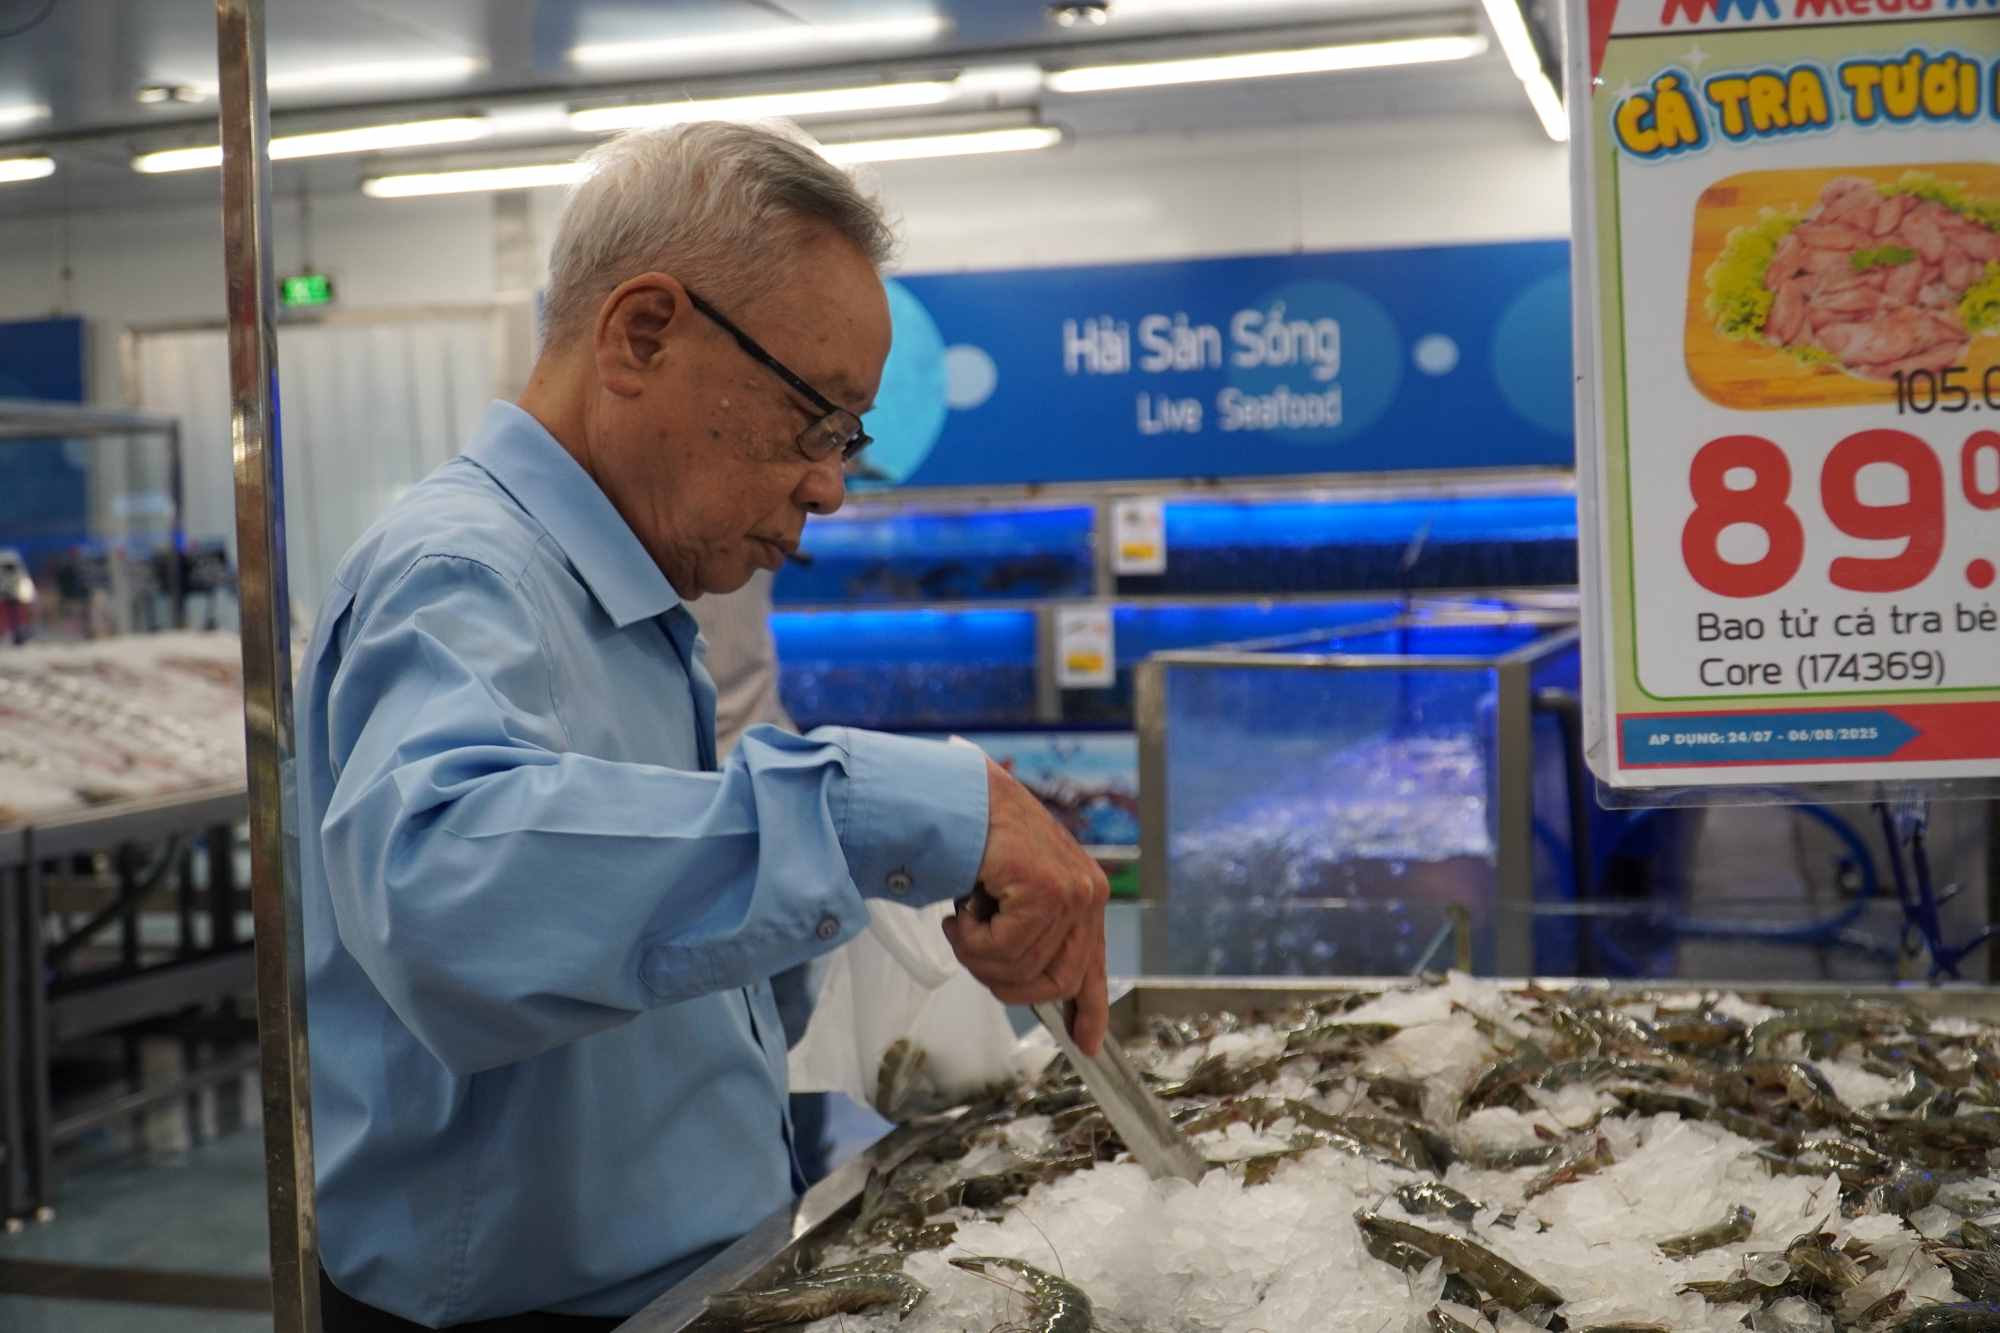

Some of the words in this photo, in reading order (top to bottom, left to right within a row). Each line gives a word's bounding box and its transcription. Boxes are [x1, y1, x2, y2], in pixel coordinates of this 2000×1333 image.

[1616, 75, 1699, 153] CÁ
[1707, 70, 1828, 136] TRA
[1838, 53, 1978, 121] TƯƠI
[1136, 391, 1202, 434] Live
[1217, 384, 1342, 431] Seafood
[1698, 611, 1764, 642] Bao
[1779, 608, 1818, 639] tử
[1833, 606, 1876, 637] cá
[1890, 604, 1943, 634] tra
[1700, 657, 1782, 687] Core
[1797, 650, 1945, 689] (174369)
[1728, 730, 1774, 744] 24/07
[1787, 727, 1879, 742] 06/08/2025
